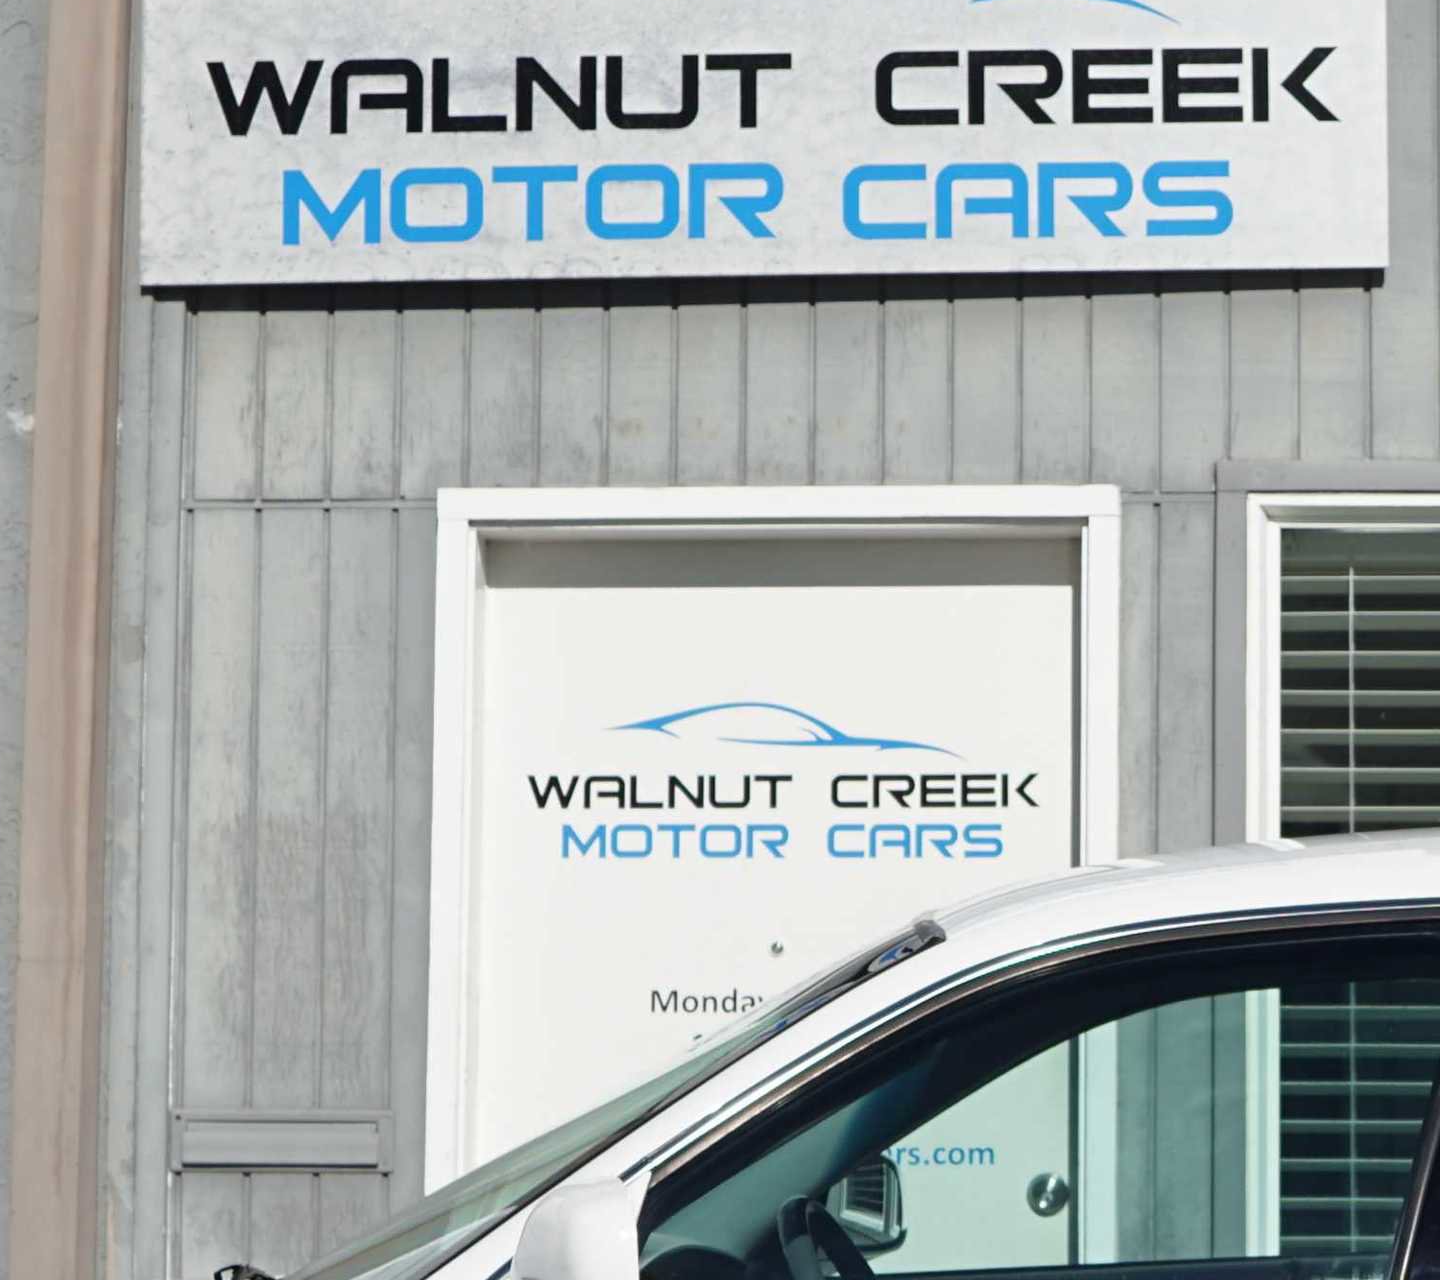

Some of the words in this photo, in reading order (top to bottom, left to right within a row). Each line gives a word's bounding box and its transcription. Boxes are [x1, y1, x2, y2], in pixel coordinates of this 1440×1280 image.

[206, 52, 793, 137] WALNUT
[874, 46, 1340, 127] CREEK
[282, 162, 785, 247] MOTOR
[842, 159, 1234, 241] CARS
[528, 774, 793, 809] WALNUT
[830, 773, 1039, 809] CREEK
[561, 824, 789, 859] MOTOR
[827, 823, 1003, 858] CARS
[887, 1146, 995, 1165] rs.com
